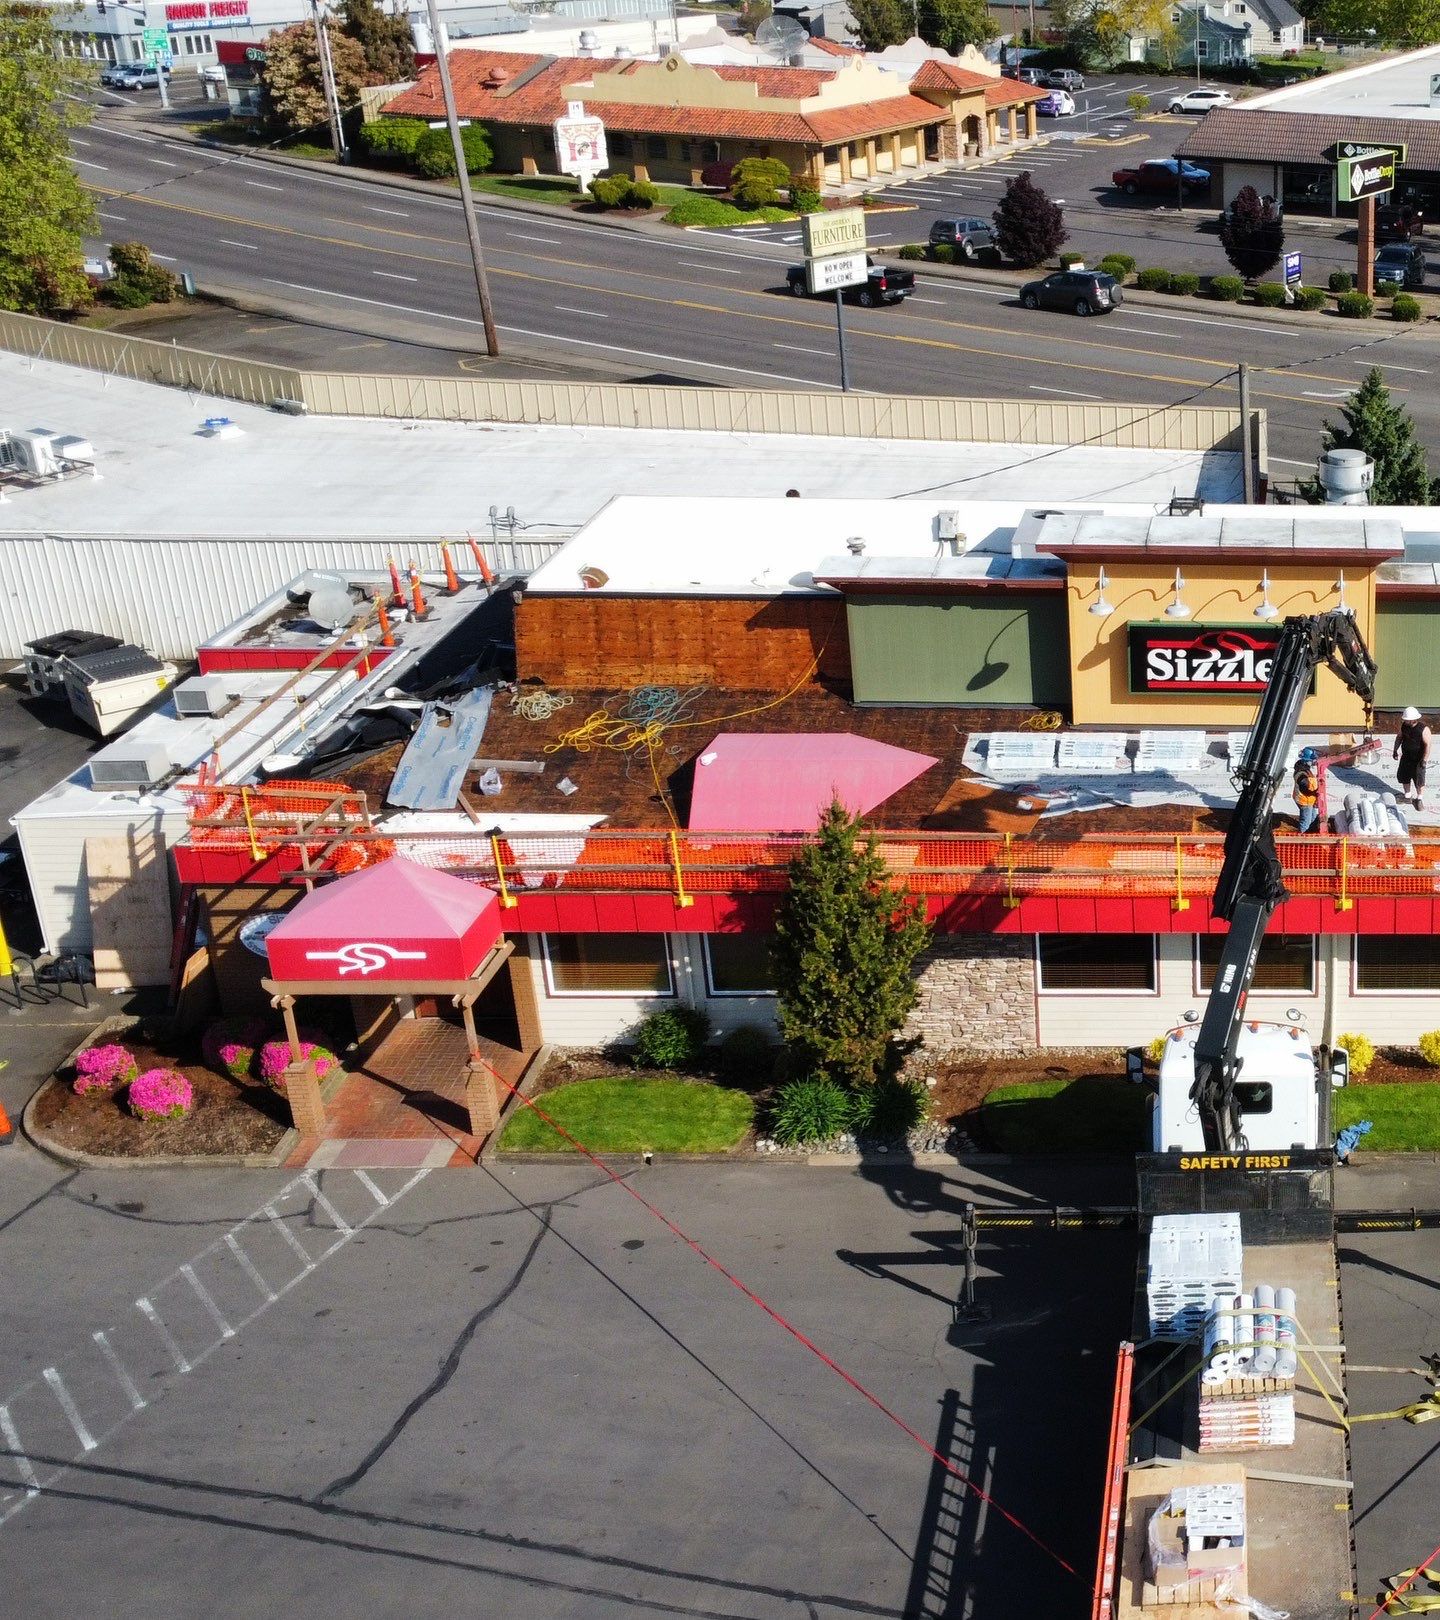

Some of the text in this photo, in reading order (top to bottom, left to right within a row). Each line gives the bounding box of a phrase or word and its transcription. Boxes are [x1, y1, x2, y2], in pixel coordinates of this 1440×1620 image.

[208, 1, 248, 18] FREIGHT
[812, 223, 864, 246] FURNITURE
[824, 260, 853, 272] NOW OPEN
[825, 272, 853, 285] WELCOME
[1147, 648, 1273, 682] Sizzle
[1180, 1155, 1290, 1169] SAFETY FIRST
